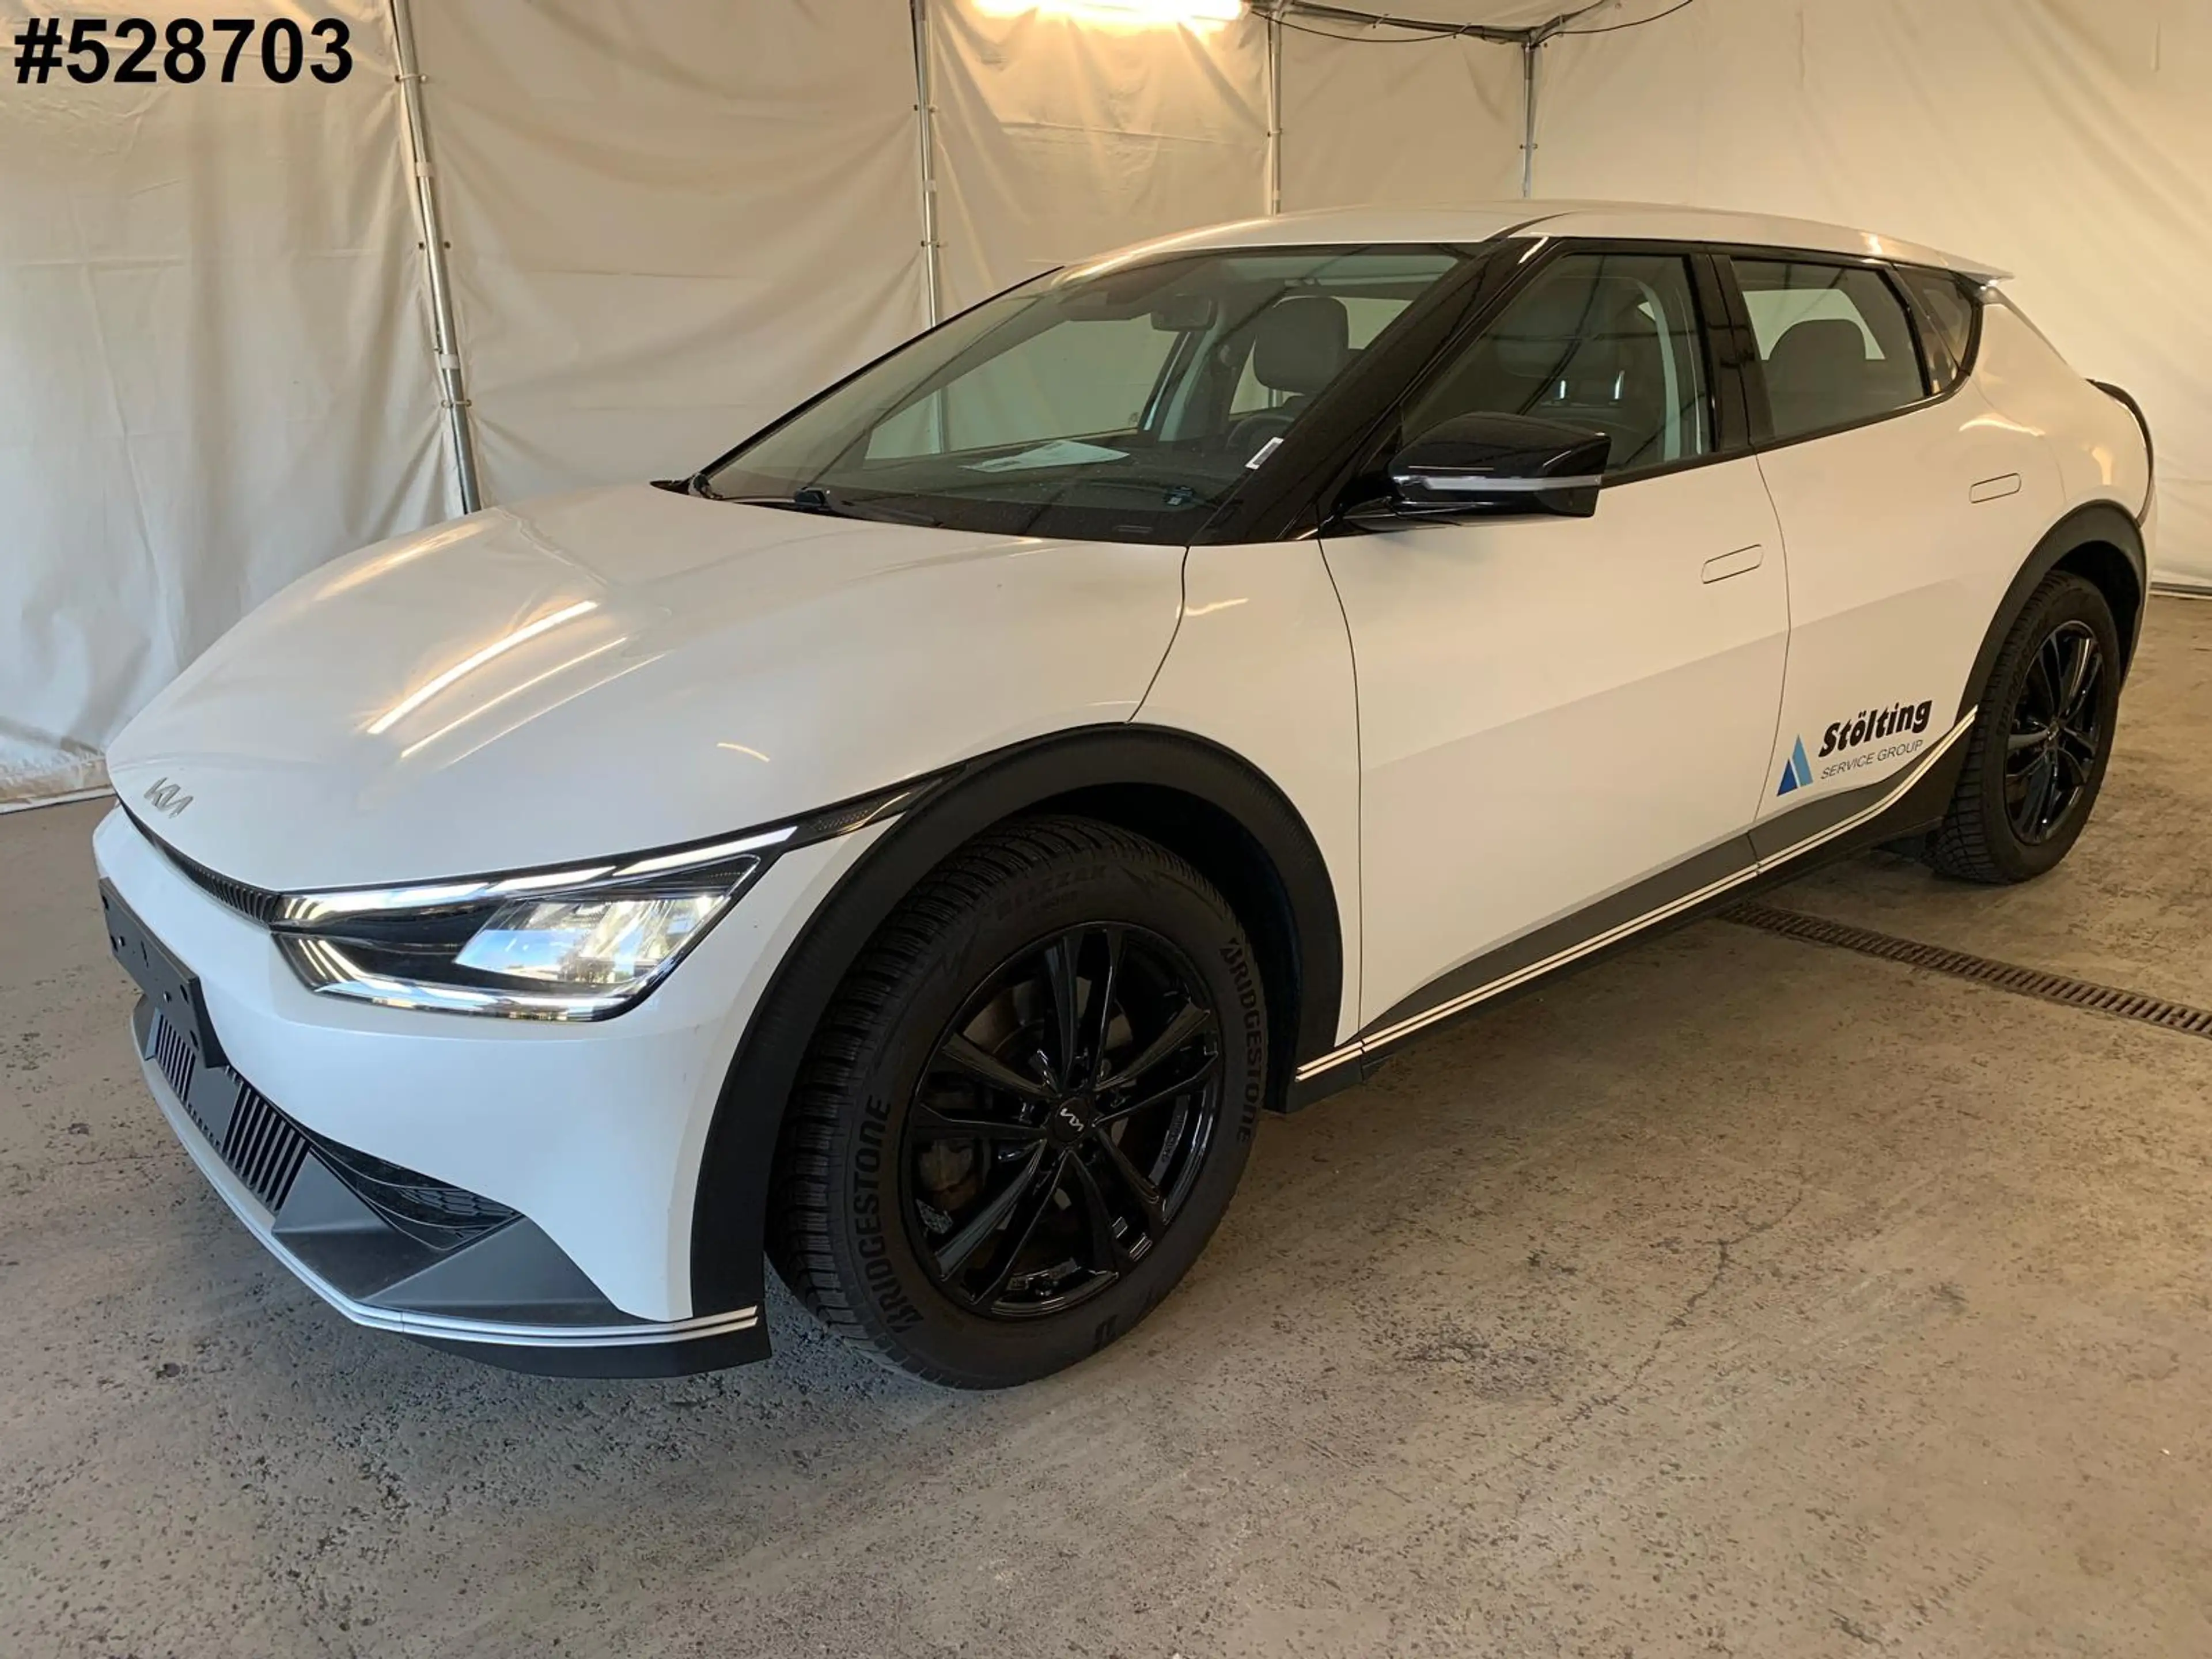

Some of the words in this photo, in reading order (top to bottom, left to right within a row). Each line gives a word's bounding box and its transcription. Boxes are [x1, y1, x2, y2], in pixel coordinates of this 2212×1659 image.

[1818, 699, 1933, 758] Stölting
[1821, 752, 1876, 779] SERVICE
[1877, 739, 1923, 762] GROUP
[1218, 937, 1263, 1143] BRIDGESTONE
[853, 1094, 925, 1334] BRIDGESTONE
